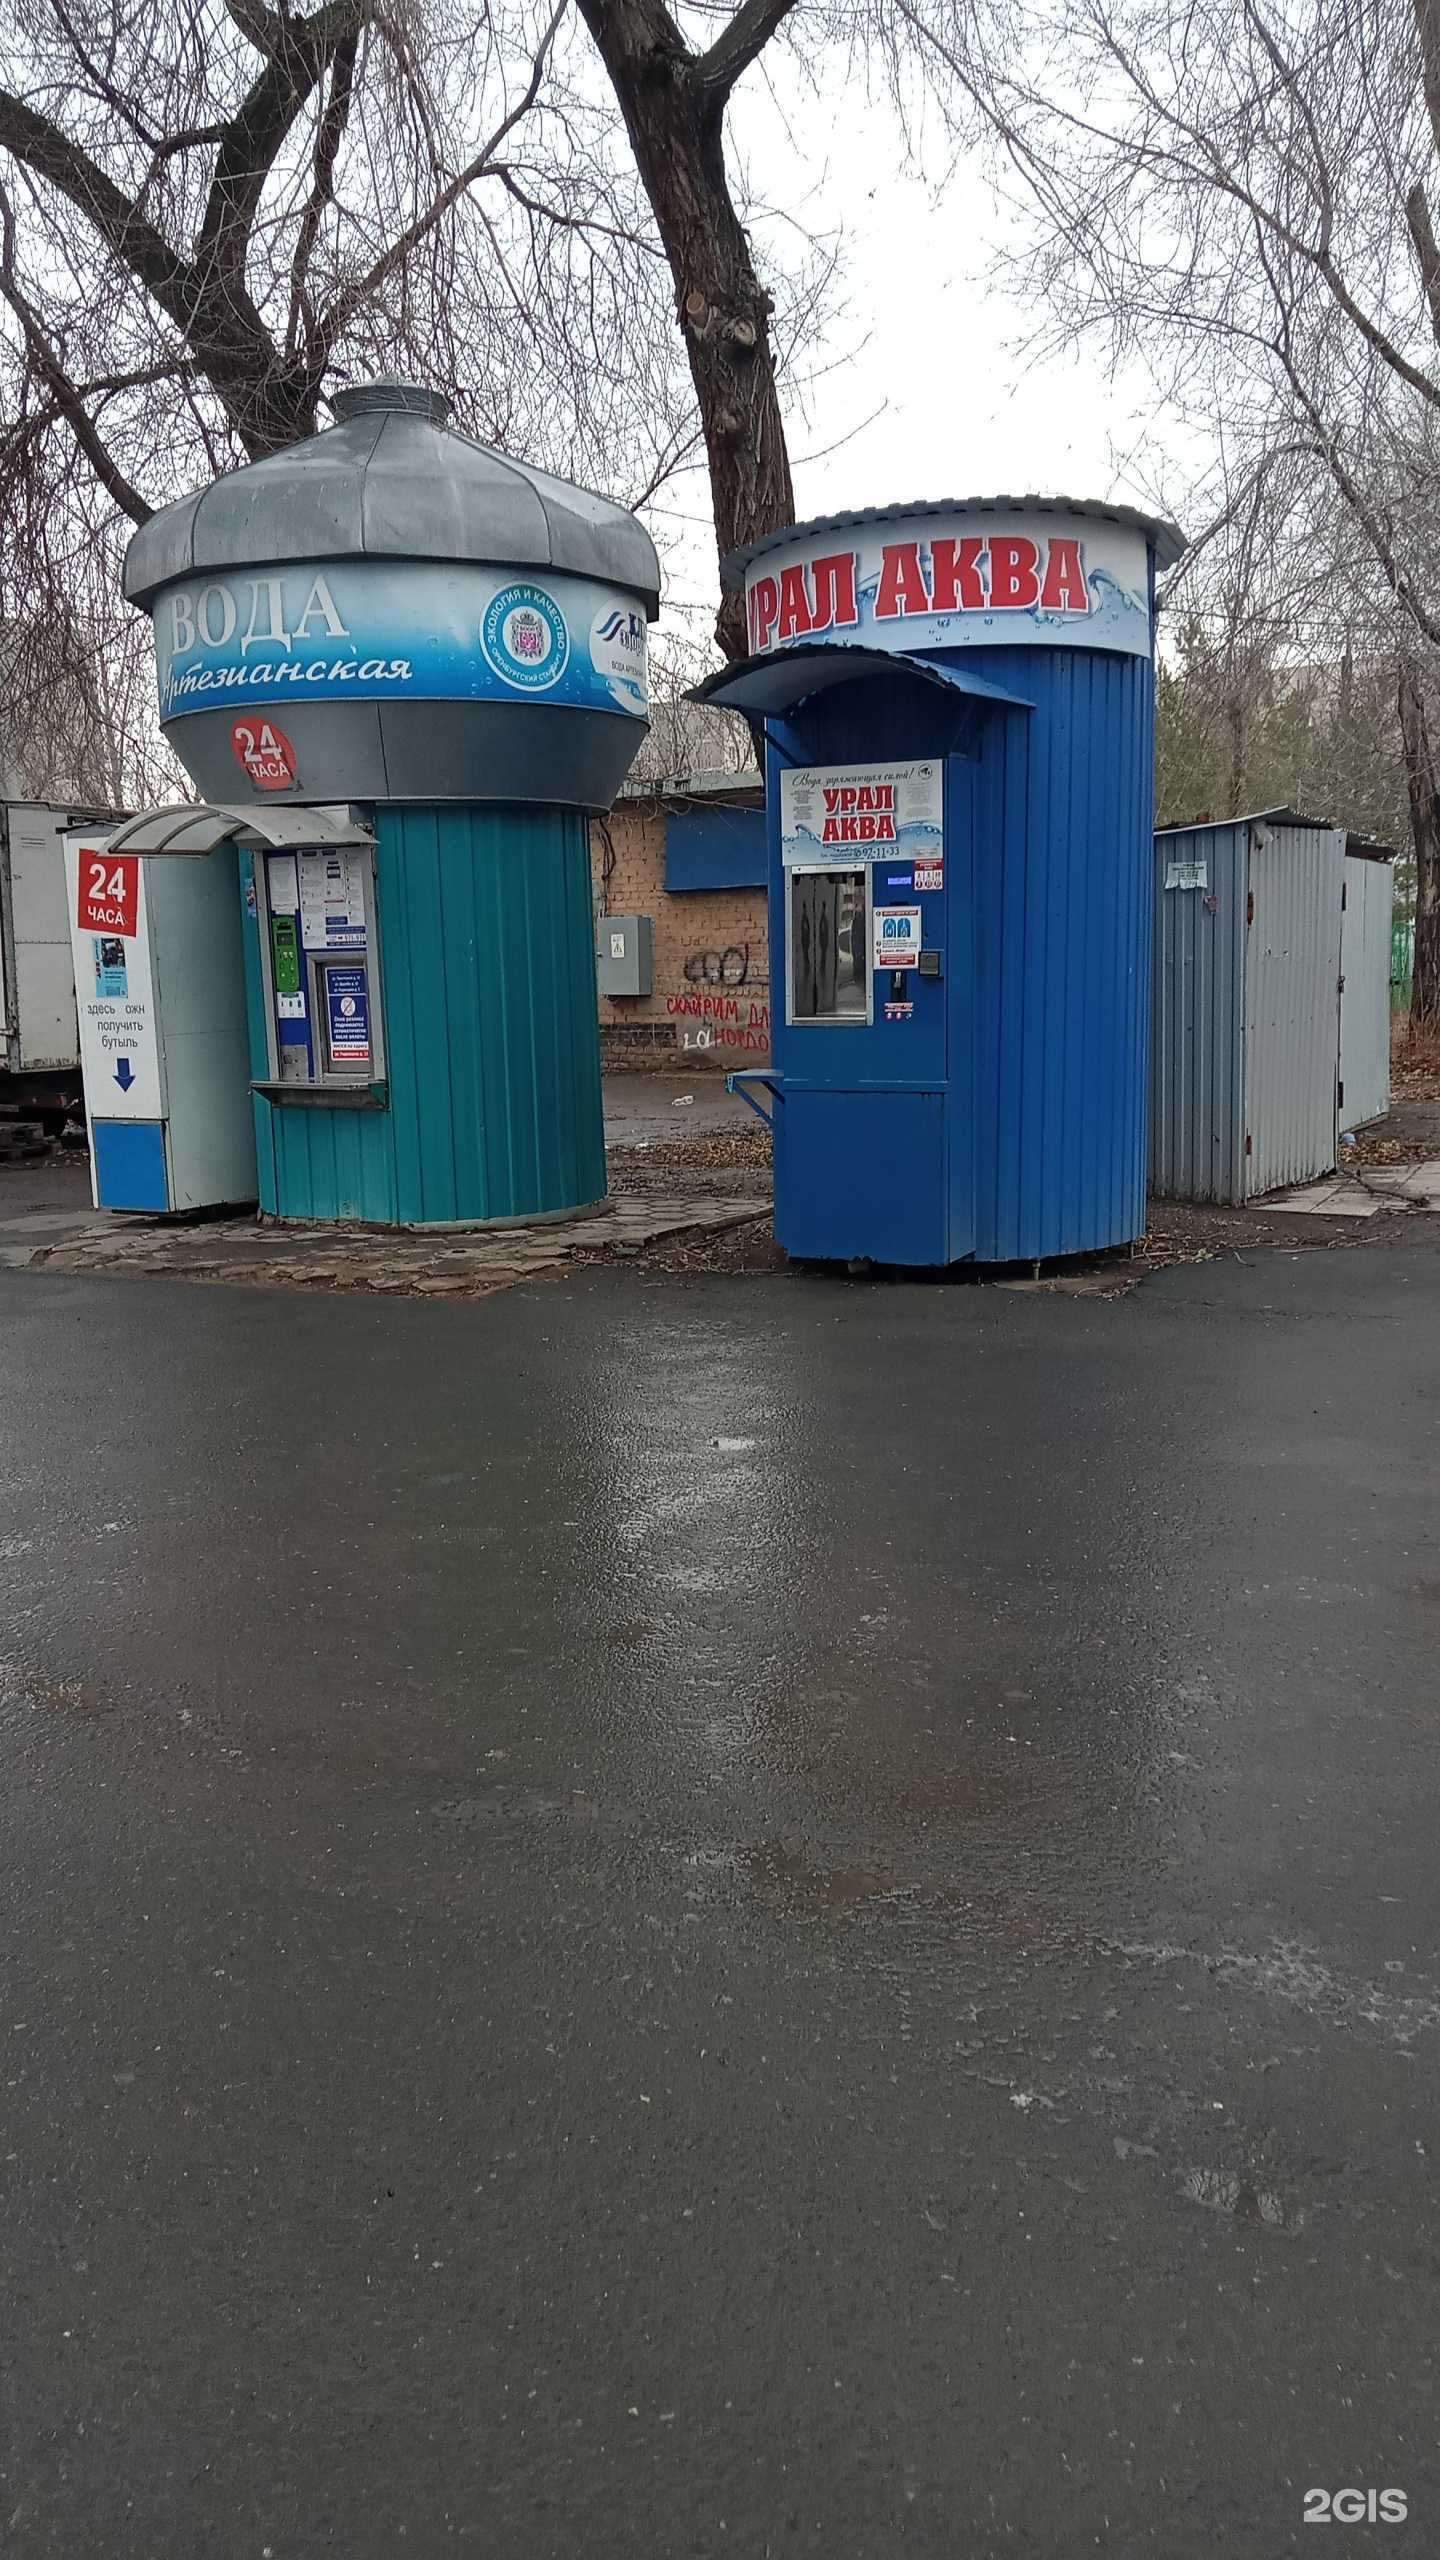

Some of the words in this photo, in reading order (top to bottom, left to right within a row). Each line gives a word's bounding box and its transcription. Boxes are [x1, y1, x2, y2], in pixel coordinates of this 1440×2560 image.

[875, 537, 1089, 619] АКВА
[171, 574, 350, 657] ВОДА
[487, 589, 521, 644] ЭКОЛОГИЯ
[523, 589, 531, 600] И
[533, 591, 565, 650] КАЧЕСТВО
[161, 645, 413, 711] Артезианская
[235, 725, 282, 762] 24
[249, 761, 290, 778] ЧАСА
[822, 785, 894, 814] УРАЛ
[822, 814, 896, 843] АКВА
[88, 863, 126, 904] 24
[87, 905, 125, 926] ЧАСА
[87, 1004, 116, 1016] здесь
[666, 992, 739, 1022] СКАЙРИМ
[748, 1003, 769, 1029] ДЛ
[97, 1021, 143, 1034] получить
[714, 1027, 769, 1052] НОРДО
[101, 1035, 138, 1050] бутыль
